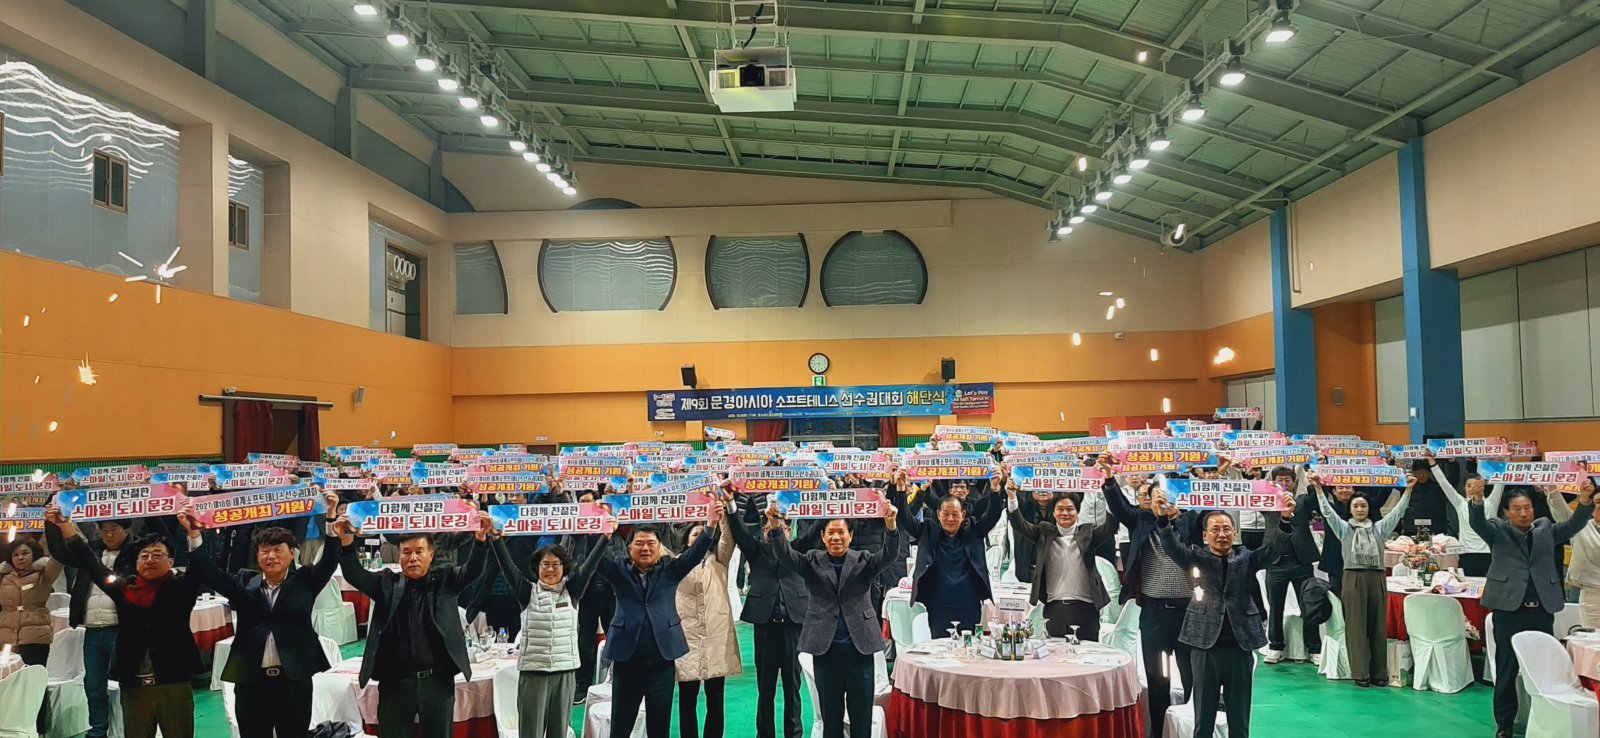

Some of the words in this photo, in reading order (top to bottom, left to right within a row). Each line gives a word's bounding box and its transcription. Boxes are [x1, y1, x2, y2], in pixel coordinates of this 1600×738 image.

[681, 398, 708, 411] 제9회
[711, 395, 773, 410] 문경아시아
[776, 393, 839, 409] 소프트테니스
[841, 390, 904, 406] 선수권대회
[907, 390, 946, 405] 해단식
[1126, 451, 1174, 462] 성공개최
[1176, 451, 1209, 462] 기원!
[1438, 447, 1462, 455] 스마일
[566, 466, 601, 475] 성공개최
[604, 466, 627, 475] 기원!
[916, 466, 958, 476] 성공개최
[961, 466, 988, 476] 기원!
[1035, 468, 1057, 477] 다함께
[1060, 468, 1081, 477] 친절한
[1507, 463, 1531, 471] 다함께
[1534, 463, 1558, 471] 친절한
[1332, 475, 1370, 484] 성공개최
[1373, 475, 1398, 484] 기원!
[1490, 473, 1525, 482] 스마일
[1529, 473, 1551, 482] 도시
[1554, 473, 1577, 482] 문경
[478, 482, 515, 491] 성공개최
[517, 482, 541, 491] 기원!
[745, 479, 789, 490] 성공개최
[792, 479, 820, 490] 기원!
[1023, 479, 1052, 489] 스마일
[1057, 479, 1076, 489] 도시
[1081, 479, 1100, 489] 문경
[1192, 481, 1220, 491] 다함께
[1223, 481, 1251, 492] 친절한
[89, 489, 117, 501] 다함께
[121, 487, 150, 498] 친절한
[632, 496, 658, 505] 다함께
[661, 494, 686, 504] 친절한
[802, 492, 827, 502] 다함께
[830, 491, 855, 500] 친절한
[1177, 494, 1214, 507] 스마일
[1220, 494, 1244, 507] 도시
[1250, 494, 1275, 507] 문경
[72, 503, 112, 519] 스마일
[117, 500, 142, 515] 도시
[148, 498, 174, 512] 문경
[214, 504, 272, 523] 성공개최
[276, 499, 314, 515] 기원!
[381, 503, 410, 513] 다함께
[414, 502, 443, 512] 친절한
[521, 506, 548, 516] 다함께
[551, 506, 578, 516] 친절한
[619, 507, 653, 520] 스마일
[658, 507, 680, 519] 도시
[685, 505, 707, 518] 문경
[788, 504, 822, 516] 스마일
[827, 504, 849, 515] 도시
[854, 503, 877, 515] 문경
[363, 516, 404, 530] 스마일
[409, 516, 436, 529] 도시
[441, 514, 467, 527] 문경
[505, 519, 543, 532] 스마일
[547, 518, 572, 530] 도시
[577, 517, 600, 530] 문경
